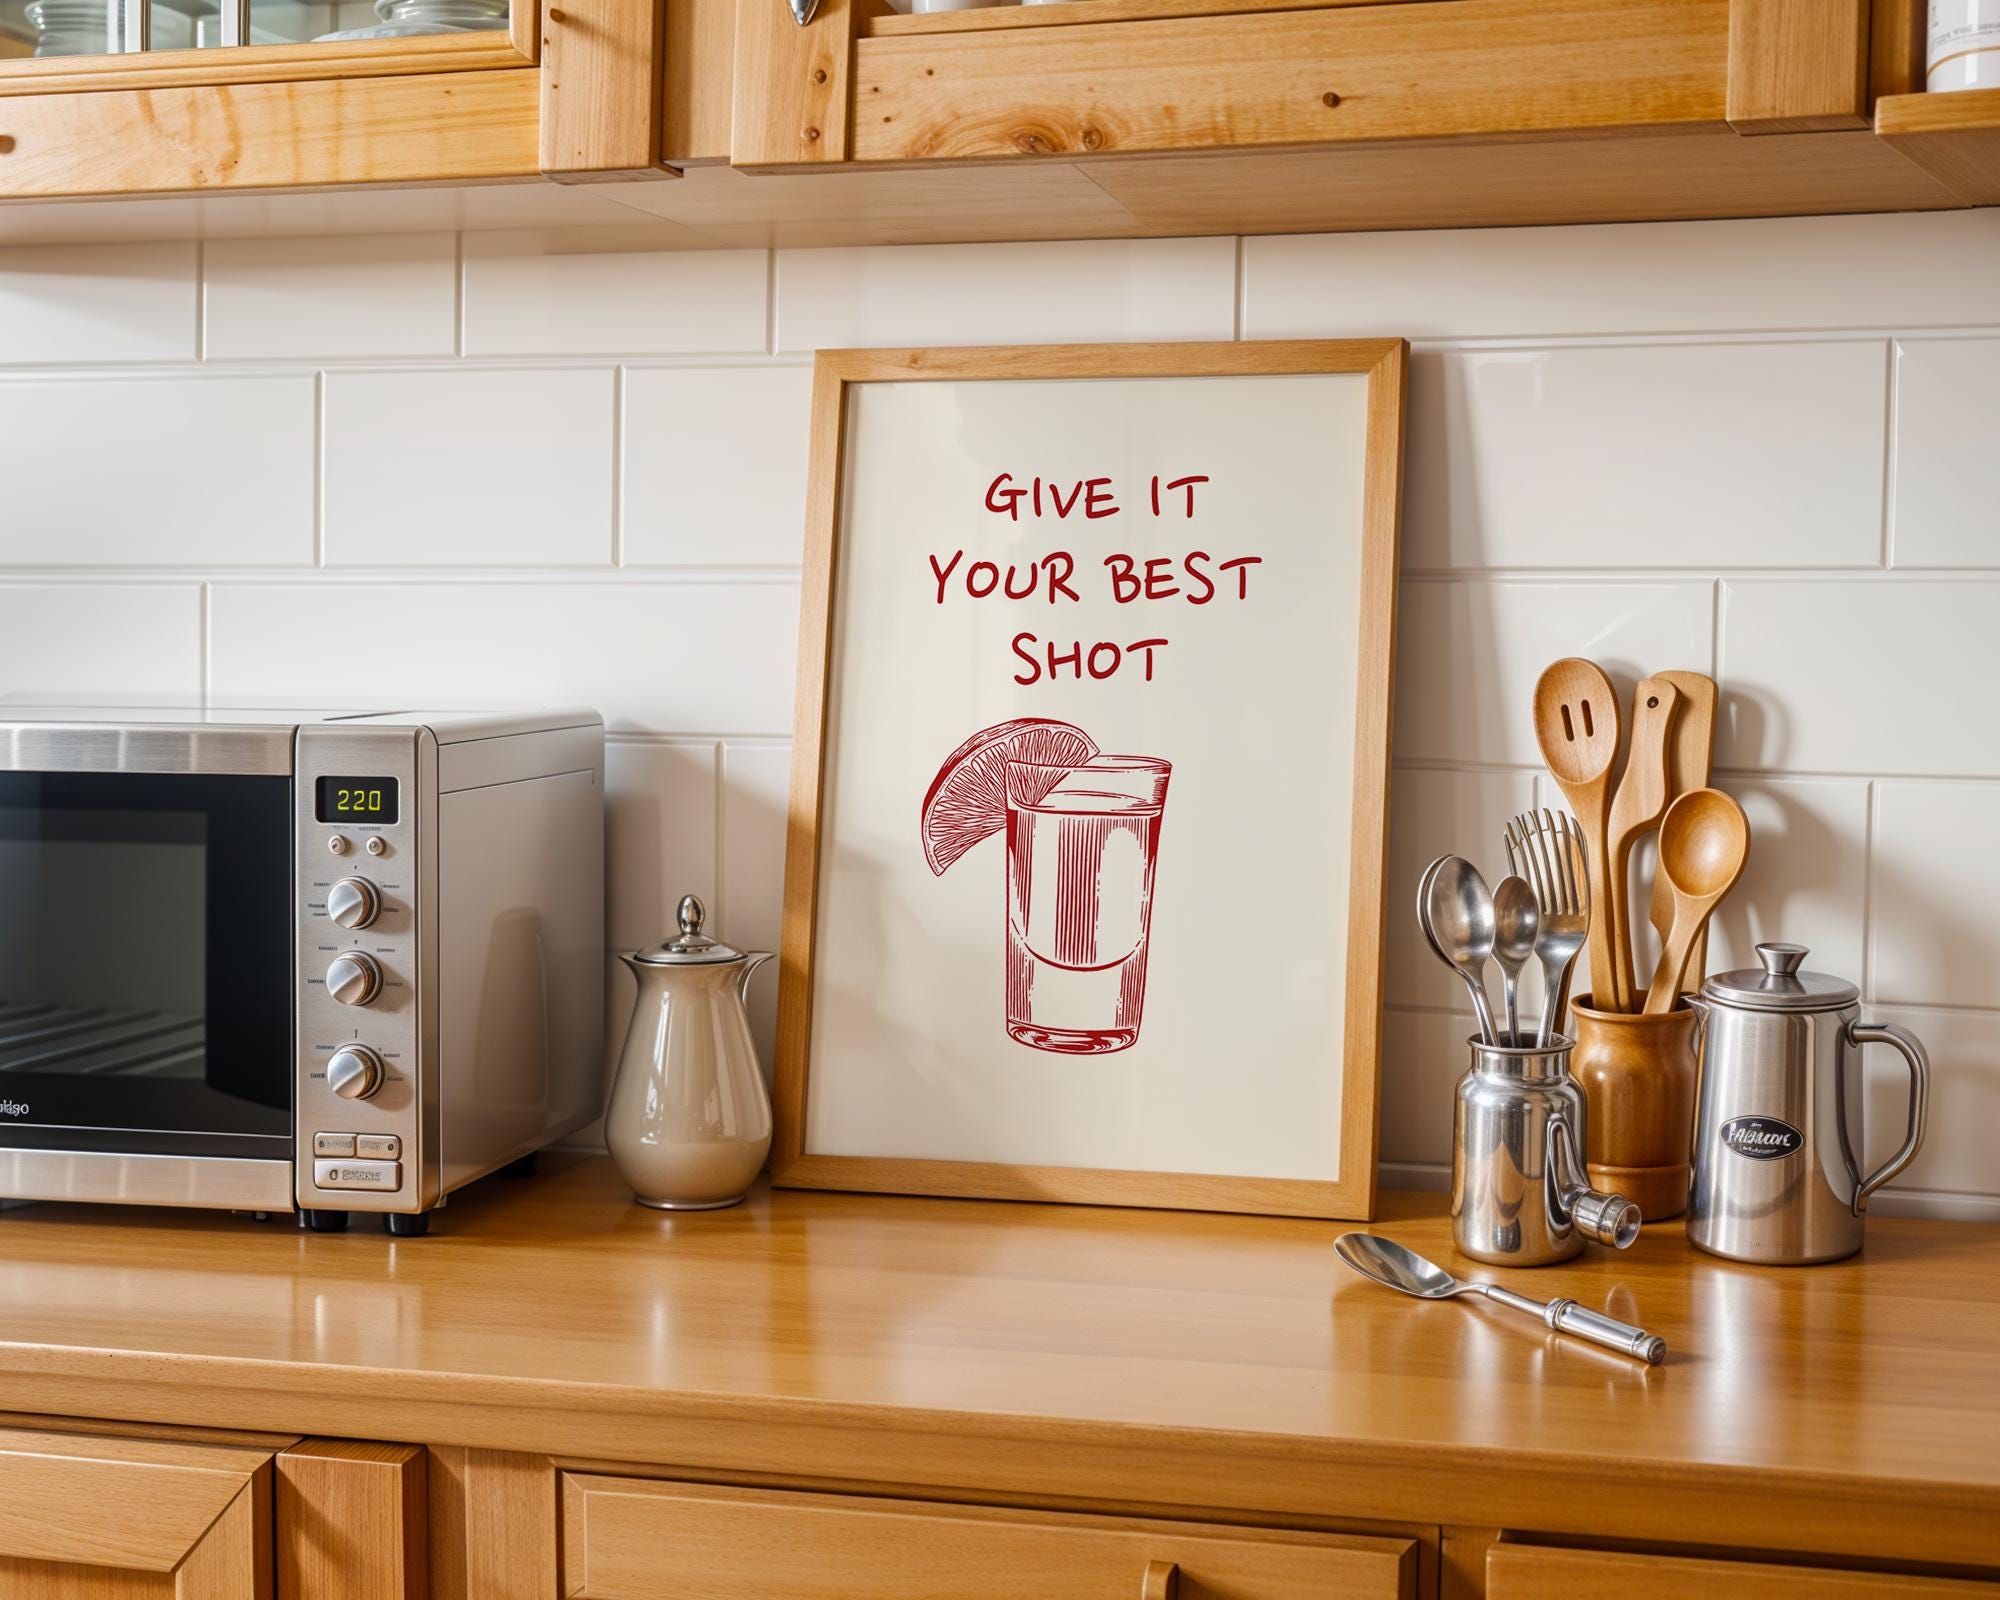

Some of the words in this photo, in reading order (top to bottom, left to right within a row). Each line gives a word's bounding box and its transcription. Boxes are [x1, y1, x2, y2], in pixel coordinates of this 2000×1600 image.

[985, 472, 1120, 521] GIVE
[1151, 475, 1209, 518] IT
[929, 549, 1080, 605] YOUR
[1103, 551, 1262, 605] BEST
[1011, 632, 1169, 686] SHOT
[337, 790, 381, 811] 220
